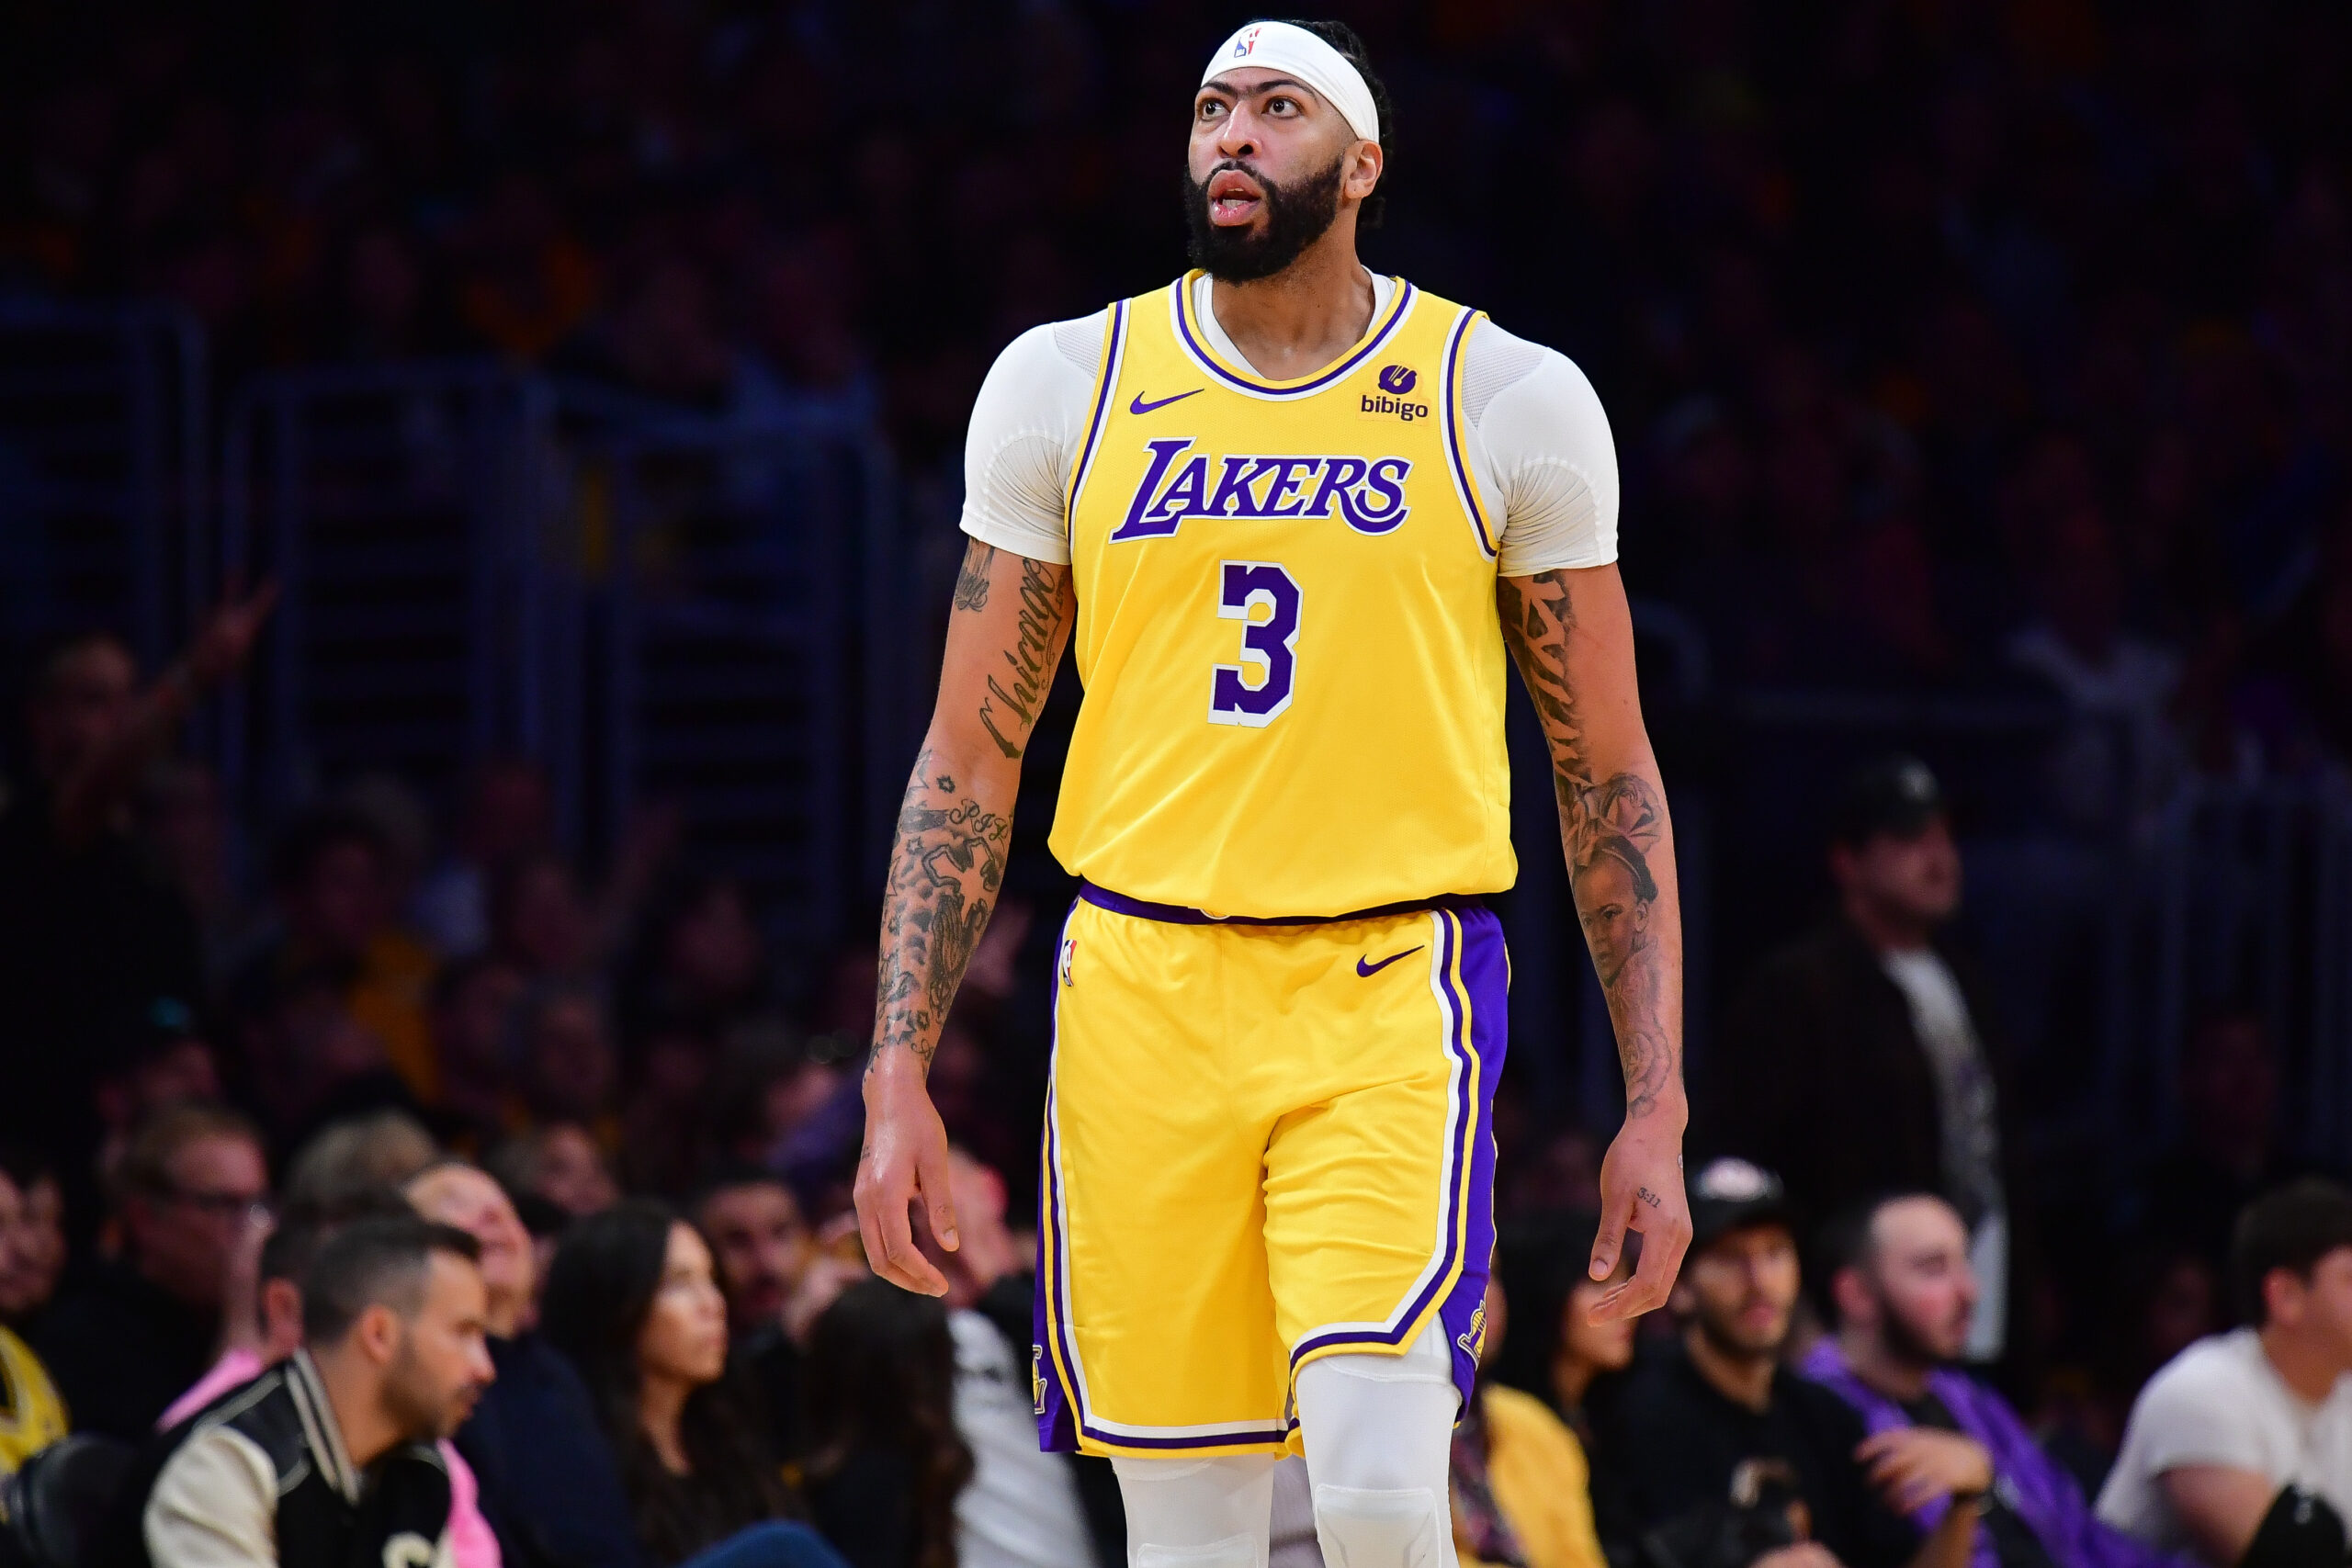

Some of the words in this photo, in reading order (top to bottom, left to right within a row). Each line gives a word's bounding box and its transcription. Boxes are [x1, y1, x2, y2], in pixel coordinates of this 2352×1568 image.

[1361, 394, 1428, 422] bibigo
[1109, 435, 1413, 545] LAKERS
[1206, 558, 1304, 728] 3
